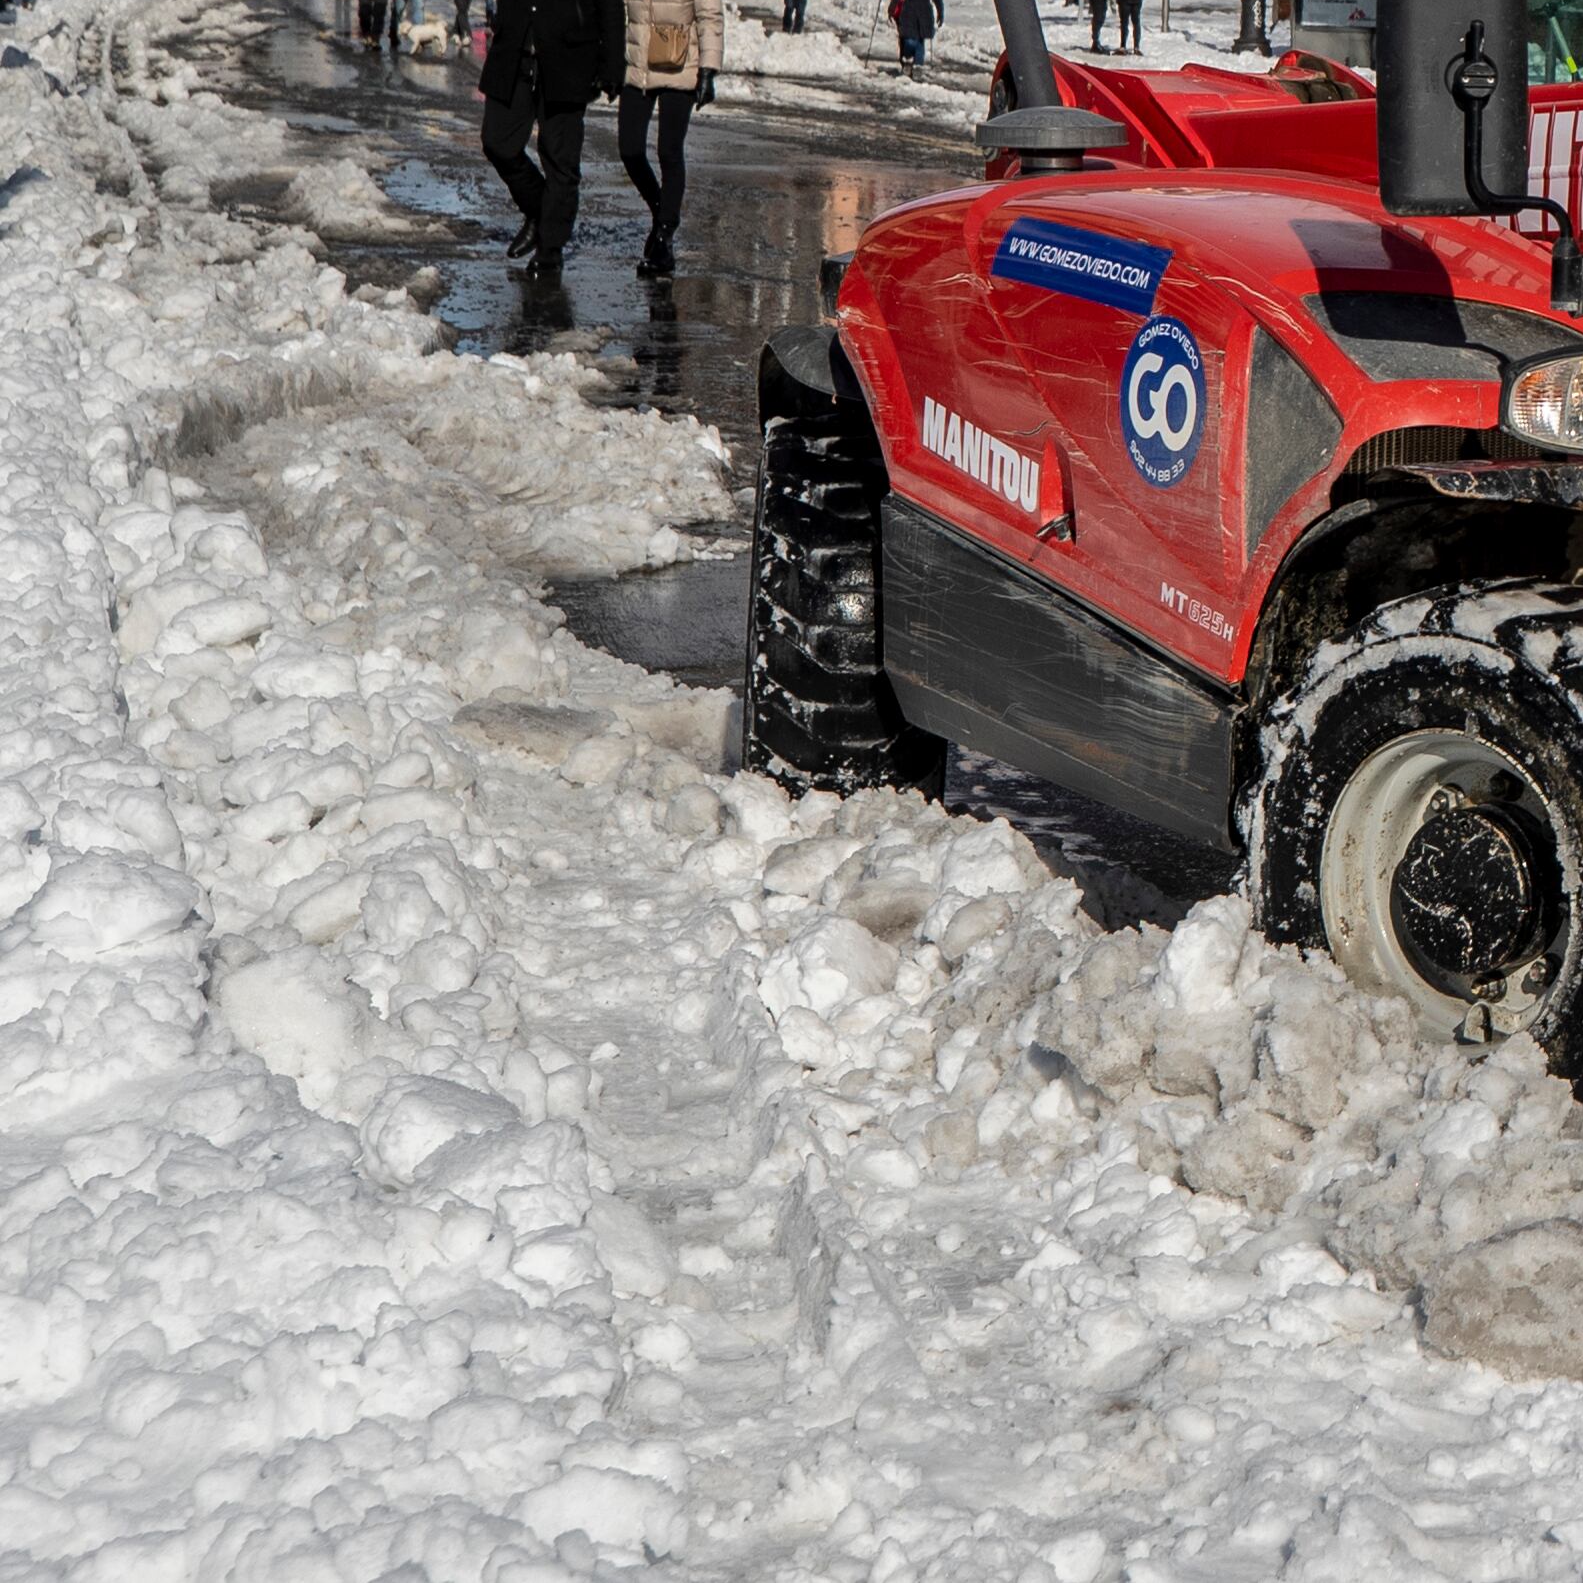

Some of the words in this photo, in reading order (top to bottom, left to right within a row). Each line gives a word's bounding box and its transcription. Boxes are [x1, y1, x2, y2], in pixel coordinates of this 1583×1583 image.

[1009, 237, 1151, 289] WWW.GOMEZOVIEDO.COM
[1138, 323, 1171, 348] GOMEZ
[1171, 326, 1199, 370] OVIEDO
[1128, 352, 1197, 451] GO
[922, 396, 1039, 513] MANITOU
[1145, 462, 1157, 480] 44
[1157, 469, 1171, 482] 88
[1171, 458, 1185, 478] 33
